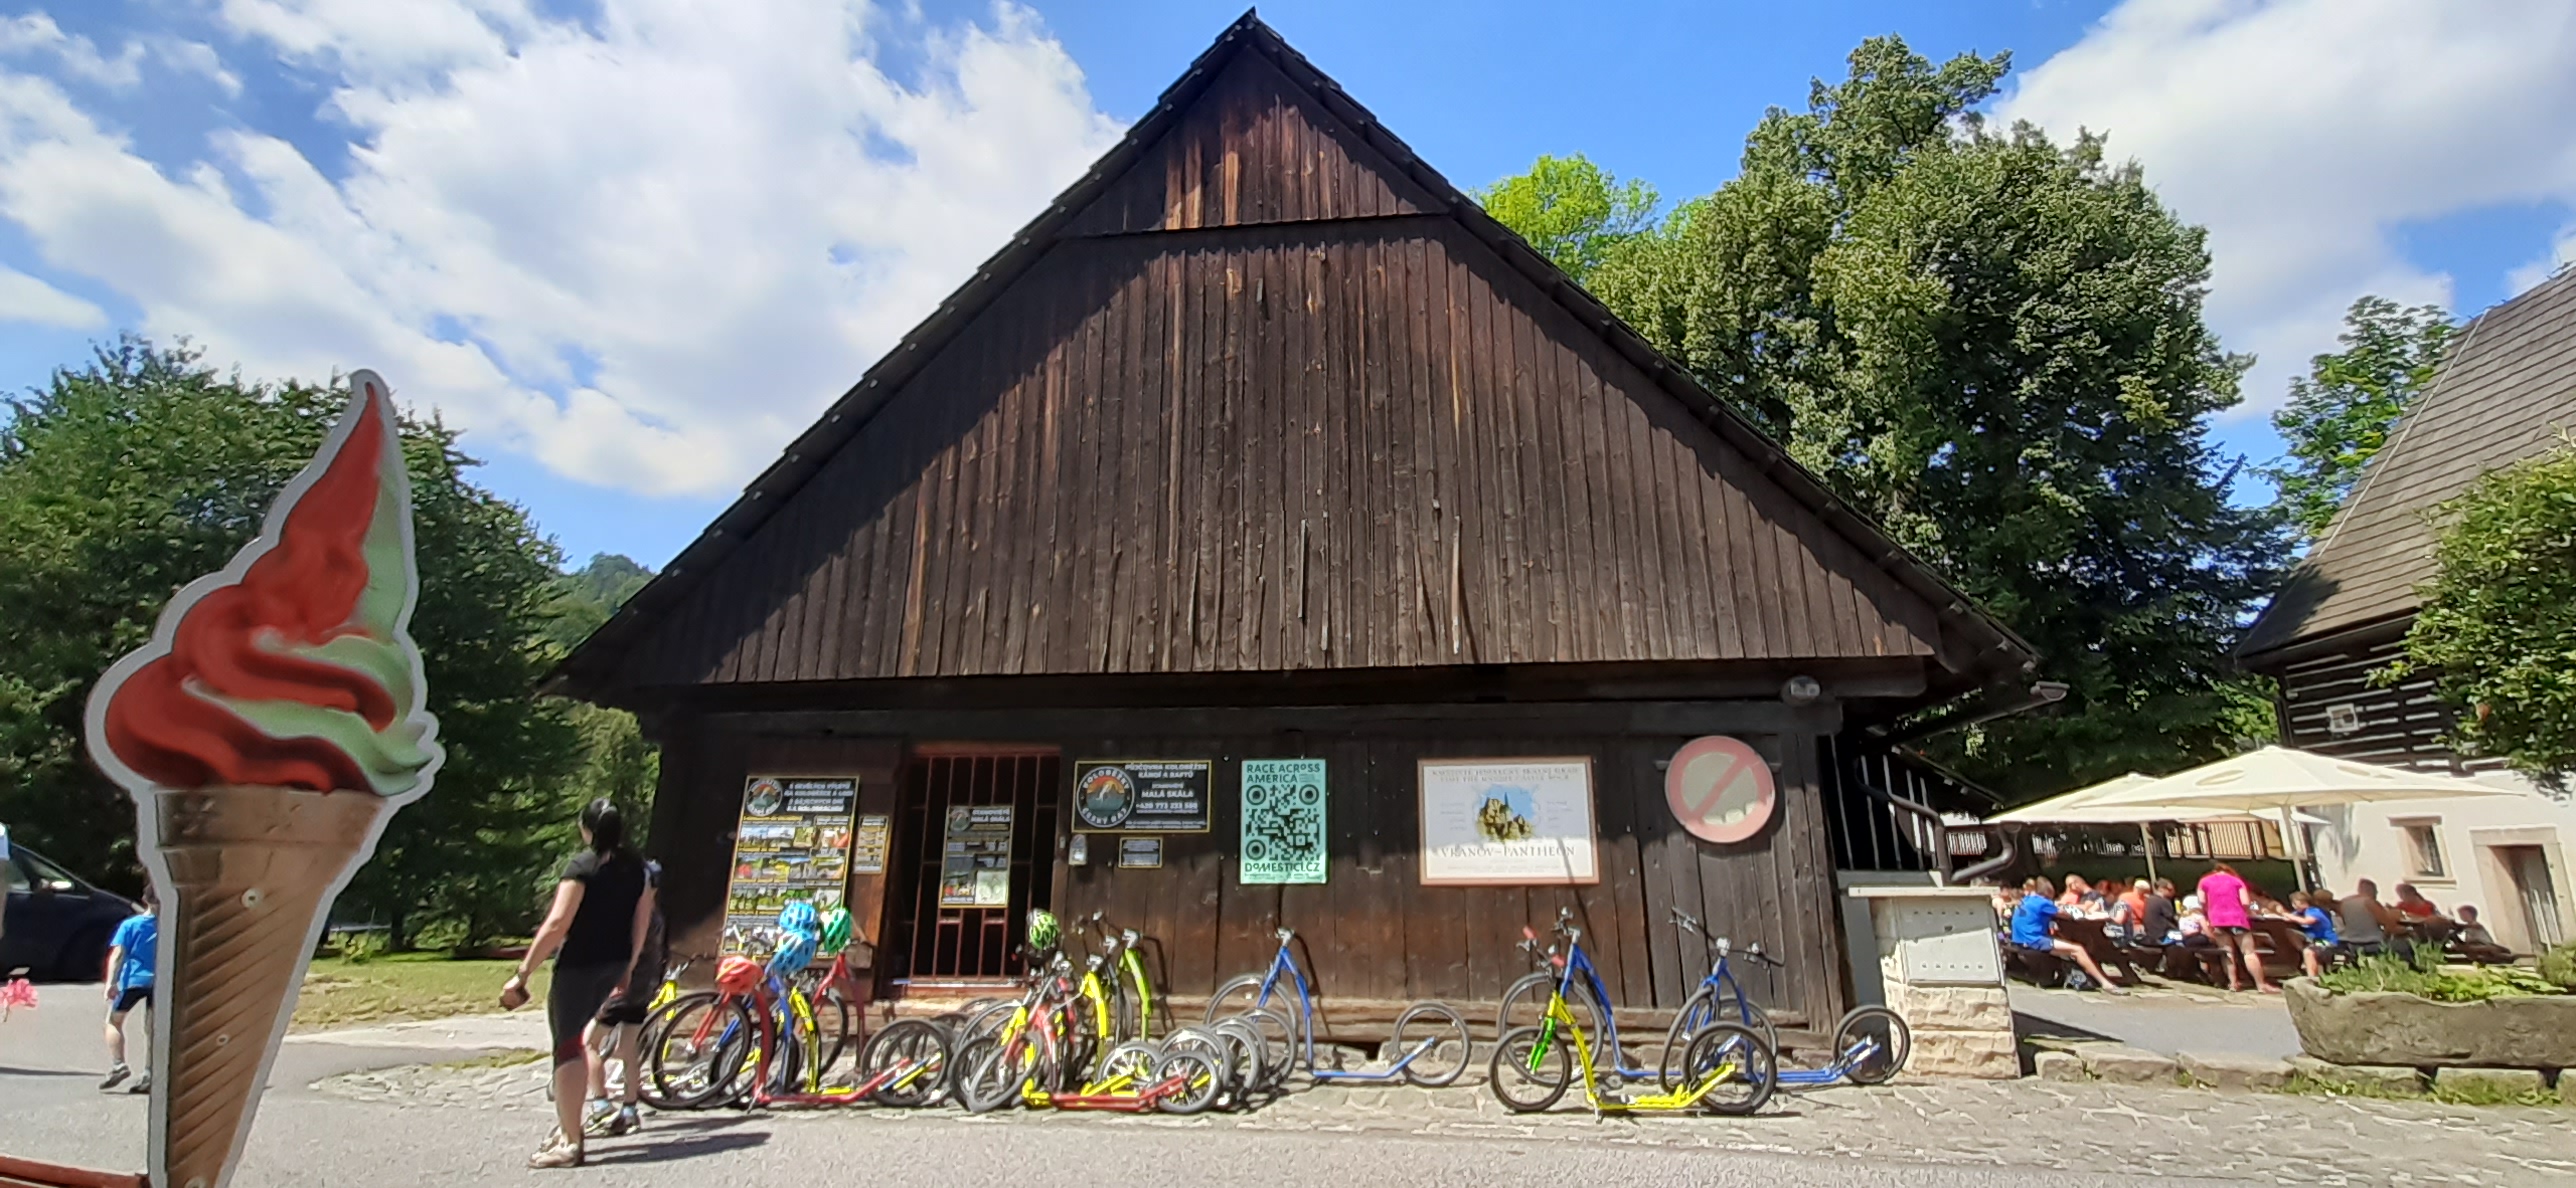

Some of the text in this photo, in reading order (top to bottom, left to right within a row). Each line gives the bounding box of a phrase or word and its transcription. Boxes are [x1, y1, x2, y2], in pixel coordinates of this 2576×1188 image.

[1246, 763, 1321, 773] RACE ACROSS
[1082, 769, 1130, 789] KOLOBĚŽKY
[1246, 774, 1298, 783] AMERICA
[1141, 790, 1194, 798] MALÁ SKÁLA
